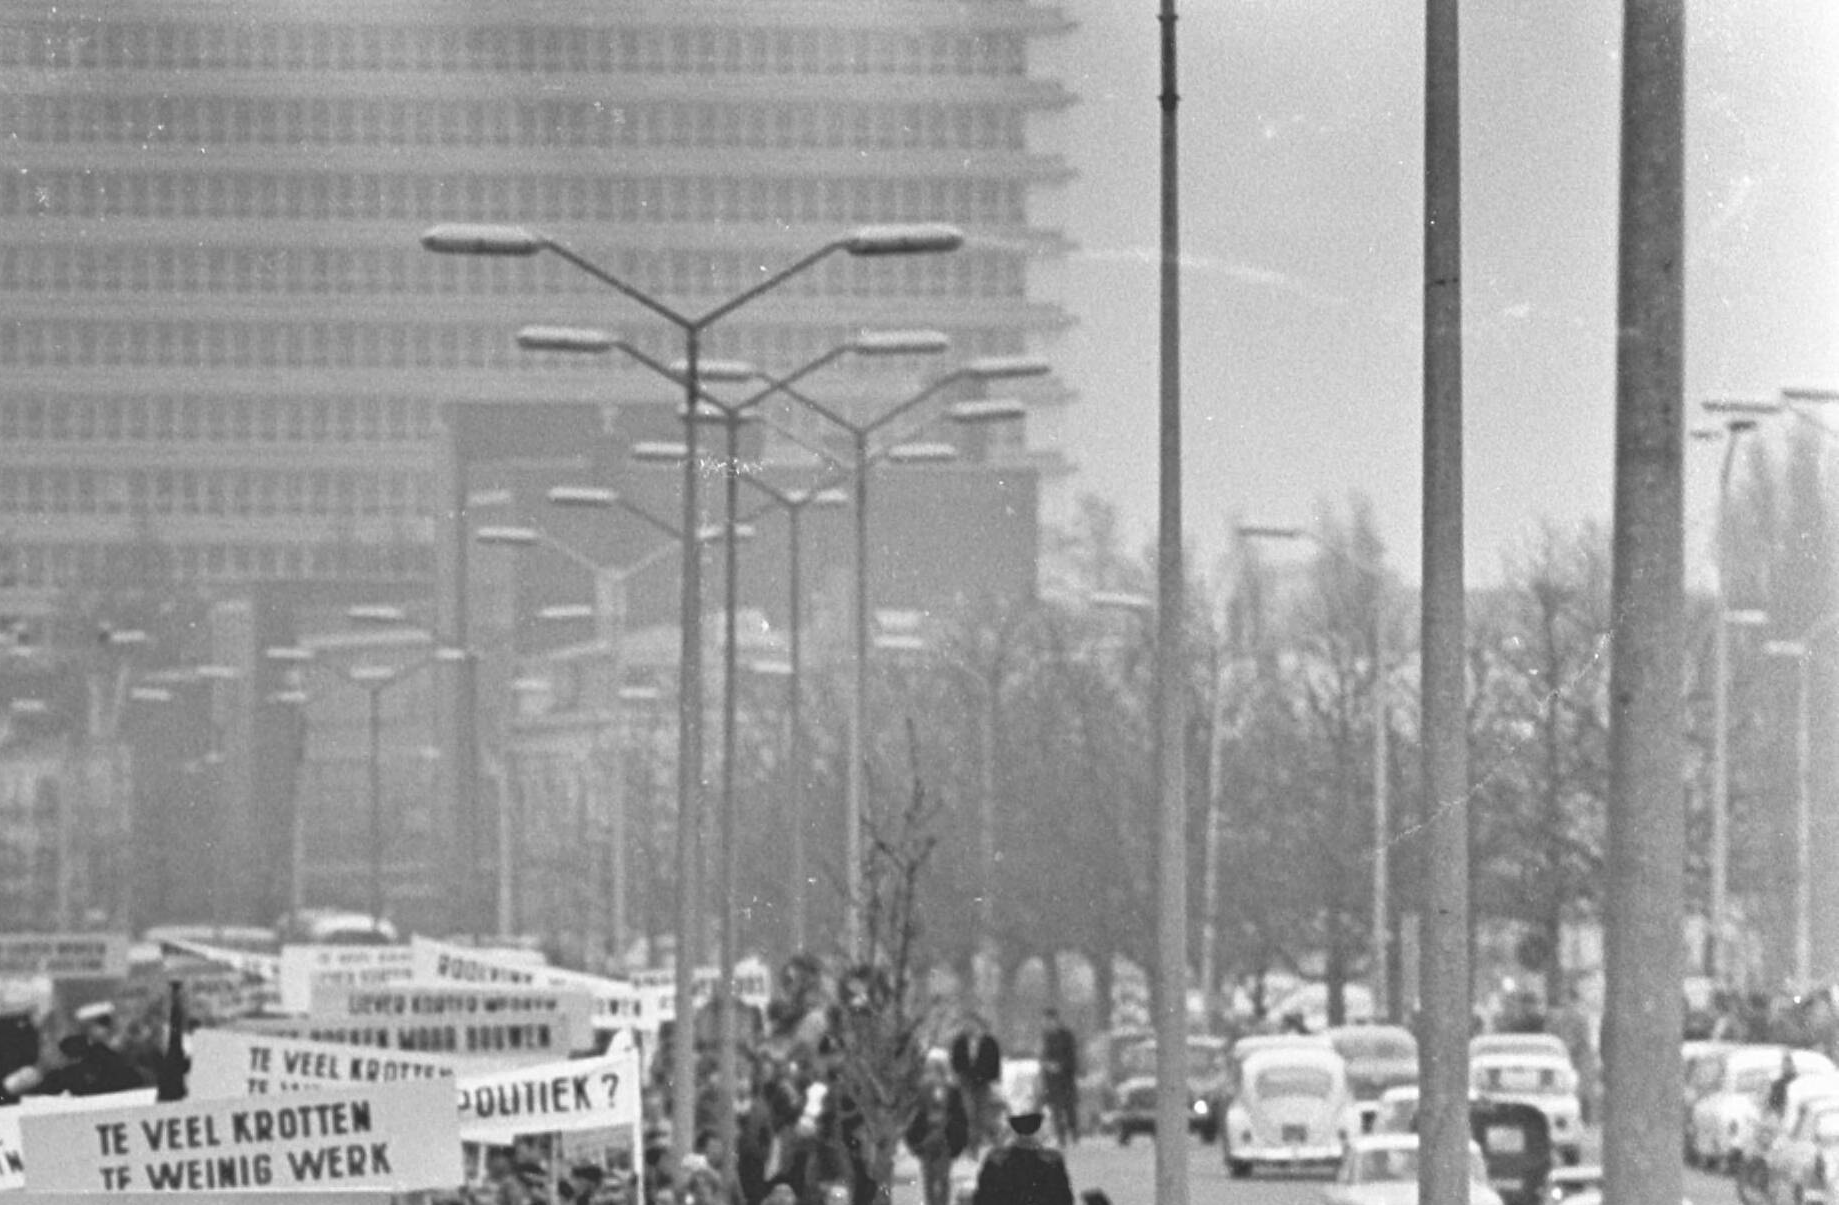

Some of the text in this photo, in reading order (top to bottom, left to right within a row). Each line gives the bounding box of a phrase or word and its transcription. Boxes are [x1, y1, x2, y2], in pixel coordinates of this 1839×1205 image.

[250, 1046, 272, 1072] TE
[283, 1050, 340, 1081] VEEL
[94, 1099, 372, 1157] TE VEEL KROTTEN
[144, 1153, 273, 1190] WEINIG
[286, 1141, 392, 1182] WERK
